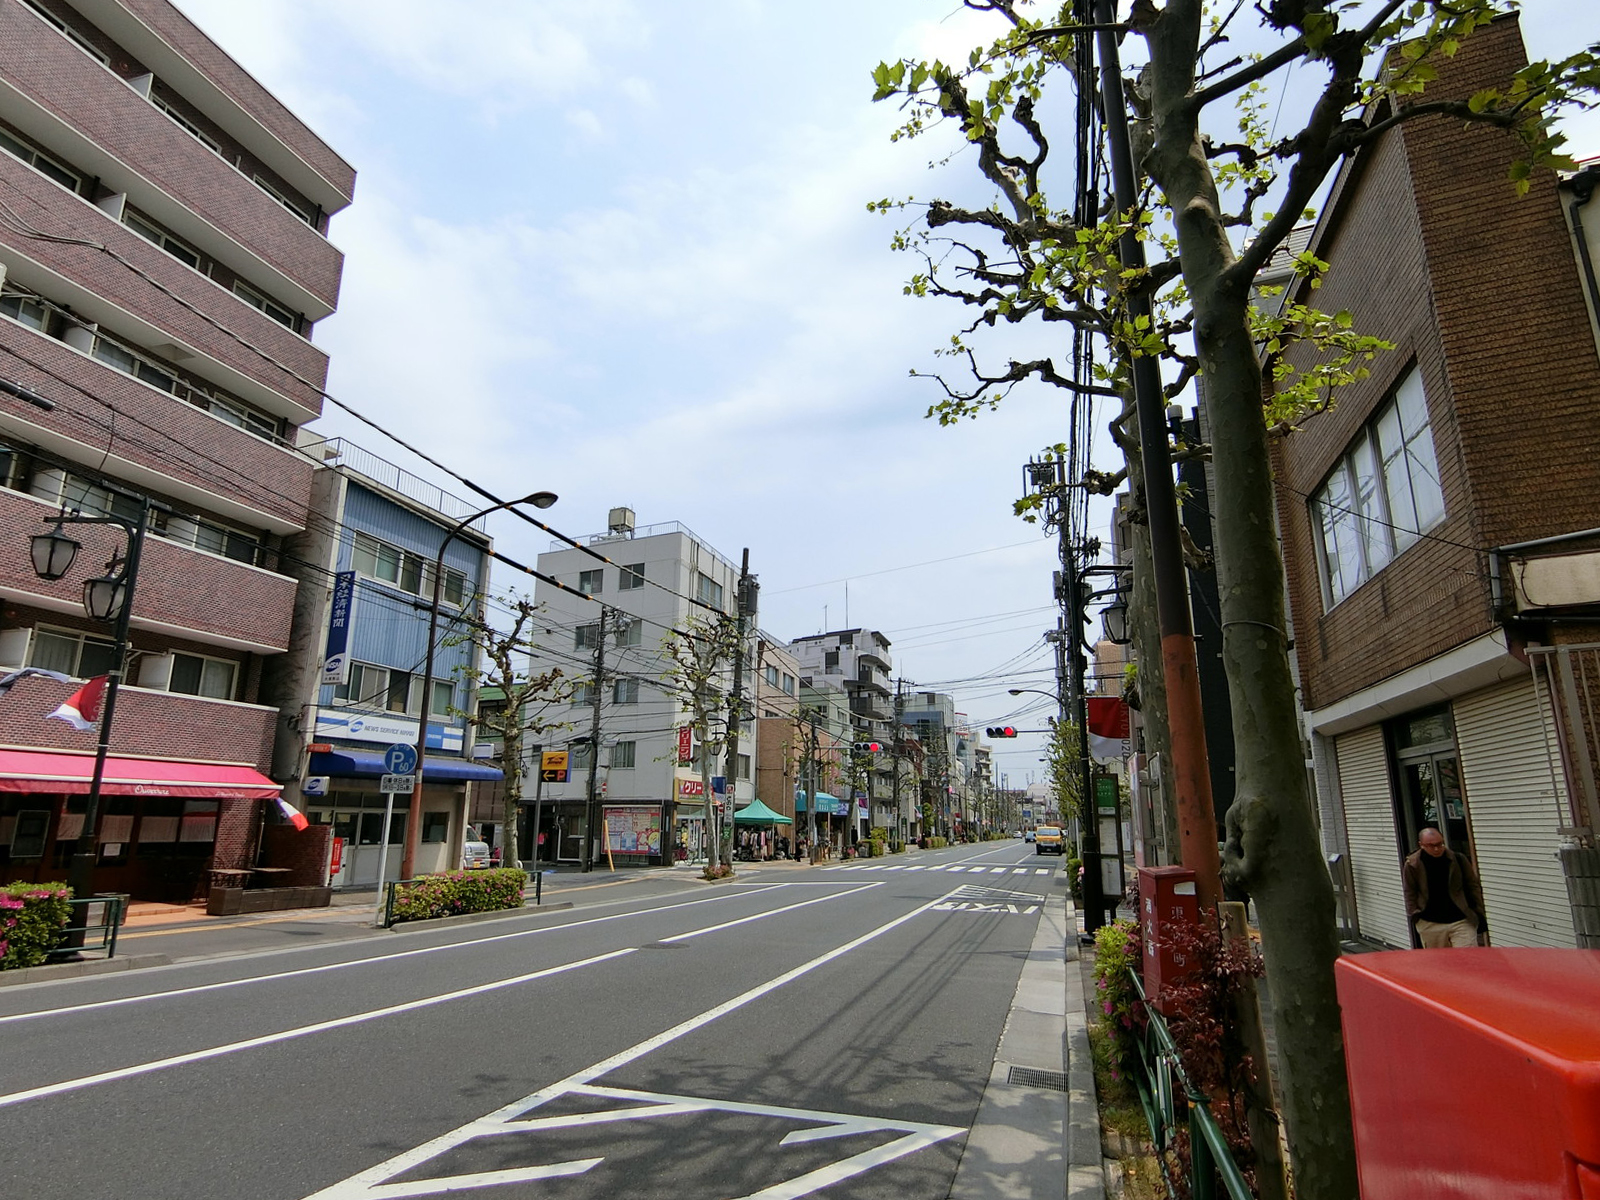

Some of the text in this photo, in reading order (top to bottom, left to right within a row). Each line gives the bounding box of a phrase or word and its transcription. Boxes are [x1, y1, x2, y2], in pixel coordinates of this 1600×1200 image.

[391, 751, 405, 771] P
[399, 762, 409, 772] 60
[557, 770, 566, 781] P
[1171, 906, 1186, 967] 東町
